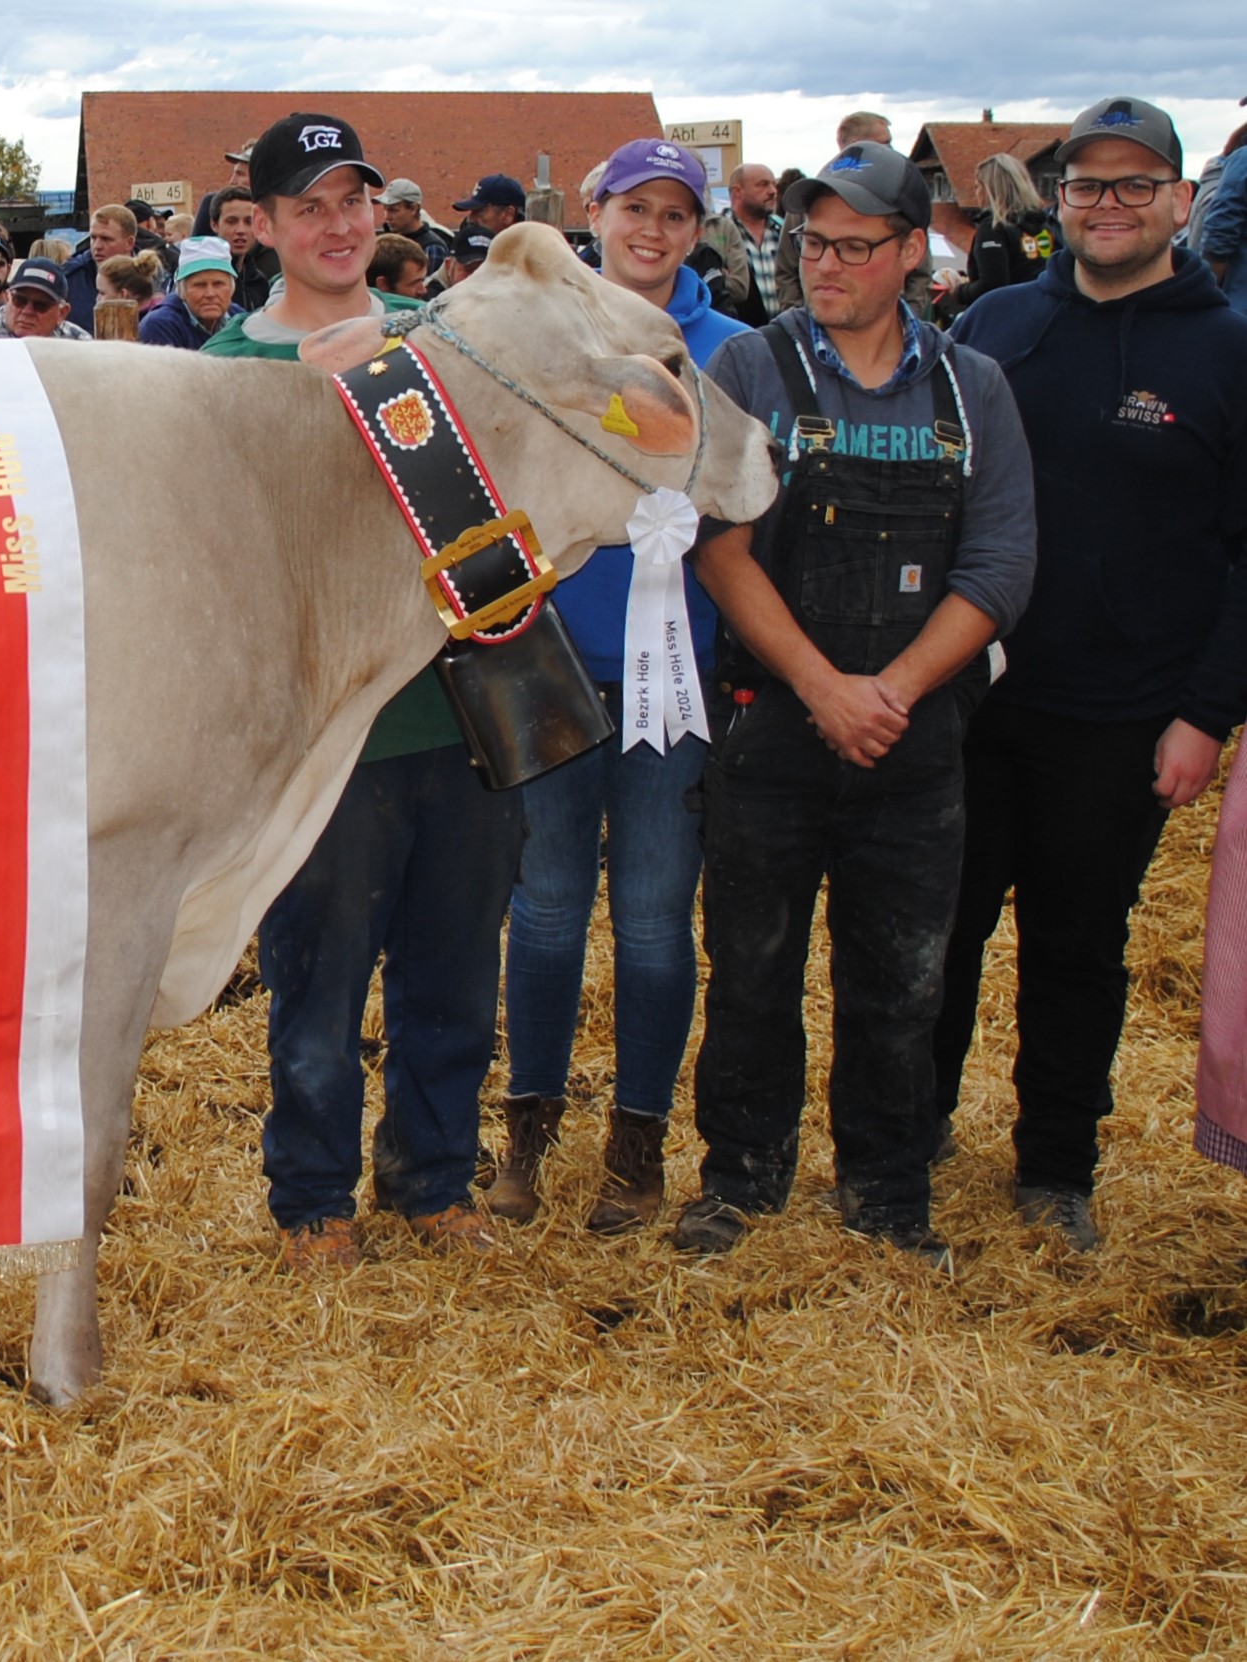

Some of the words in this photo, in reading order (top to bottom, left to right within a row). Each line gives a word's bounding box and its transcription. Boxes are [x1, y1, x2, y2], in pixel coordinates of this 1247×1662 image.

[301, 132, 342, 152] LGZ
[670, 126, 700, 142] Abt.
[711, 124, 730, 139] 44
[166, 185, 181, 199] 45
[1117, 406, 1161, 425] SWISS
[0, 514, 43, 594] Miss
[664, 620, 677, 651] Miss
[636, 651, 650, 682] Höfe
[669, 653, 683, 685] Höfe
[636, 686, 649, 729] Bezirk
[675, 688, 693, 722] 2024
